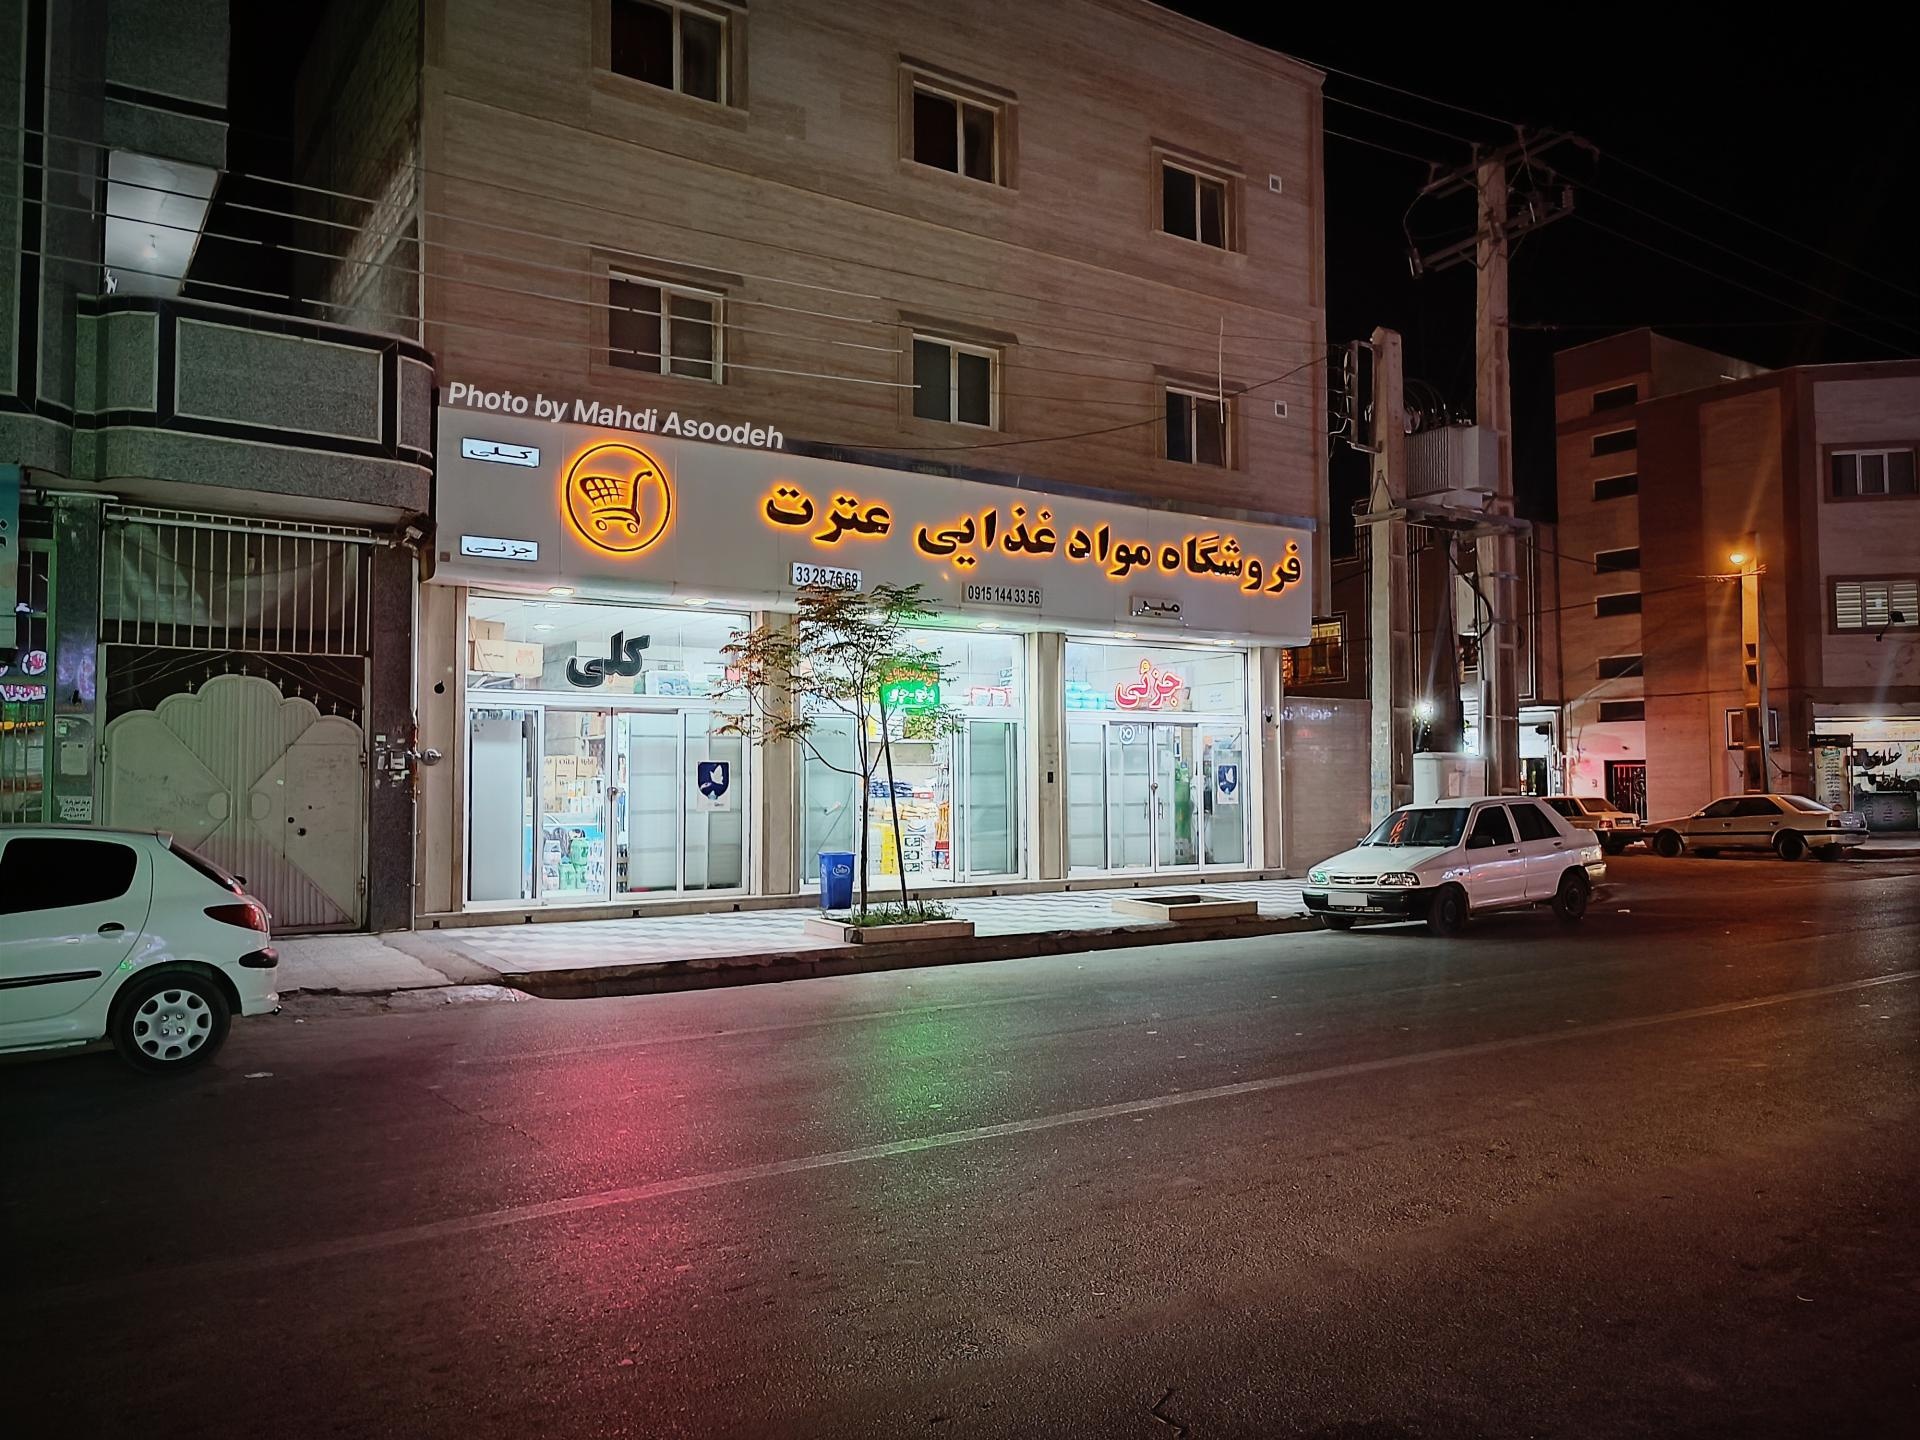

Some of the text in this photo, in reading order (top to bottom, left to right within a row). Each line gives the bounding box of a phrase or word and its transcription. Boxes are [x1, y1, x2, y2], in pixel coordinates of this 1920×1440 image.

[469, 446, 533, 460] کلی
[766, 487, 1301, 593] فروشگاه مواد غذایی عترت
[566, 630, 650, 688] کلی
[1115, 658, 1183, 709] جزئی
